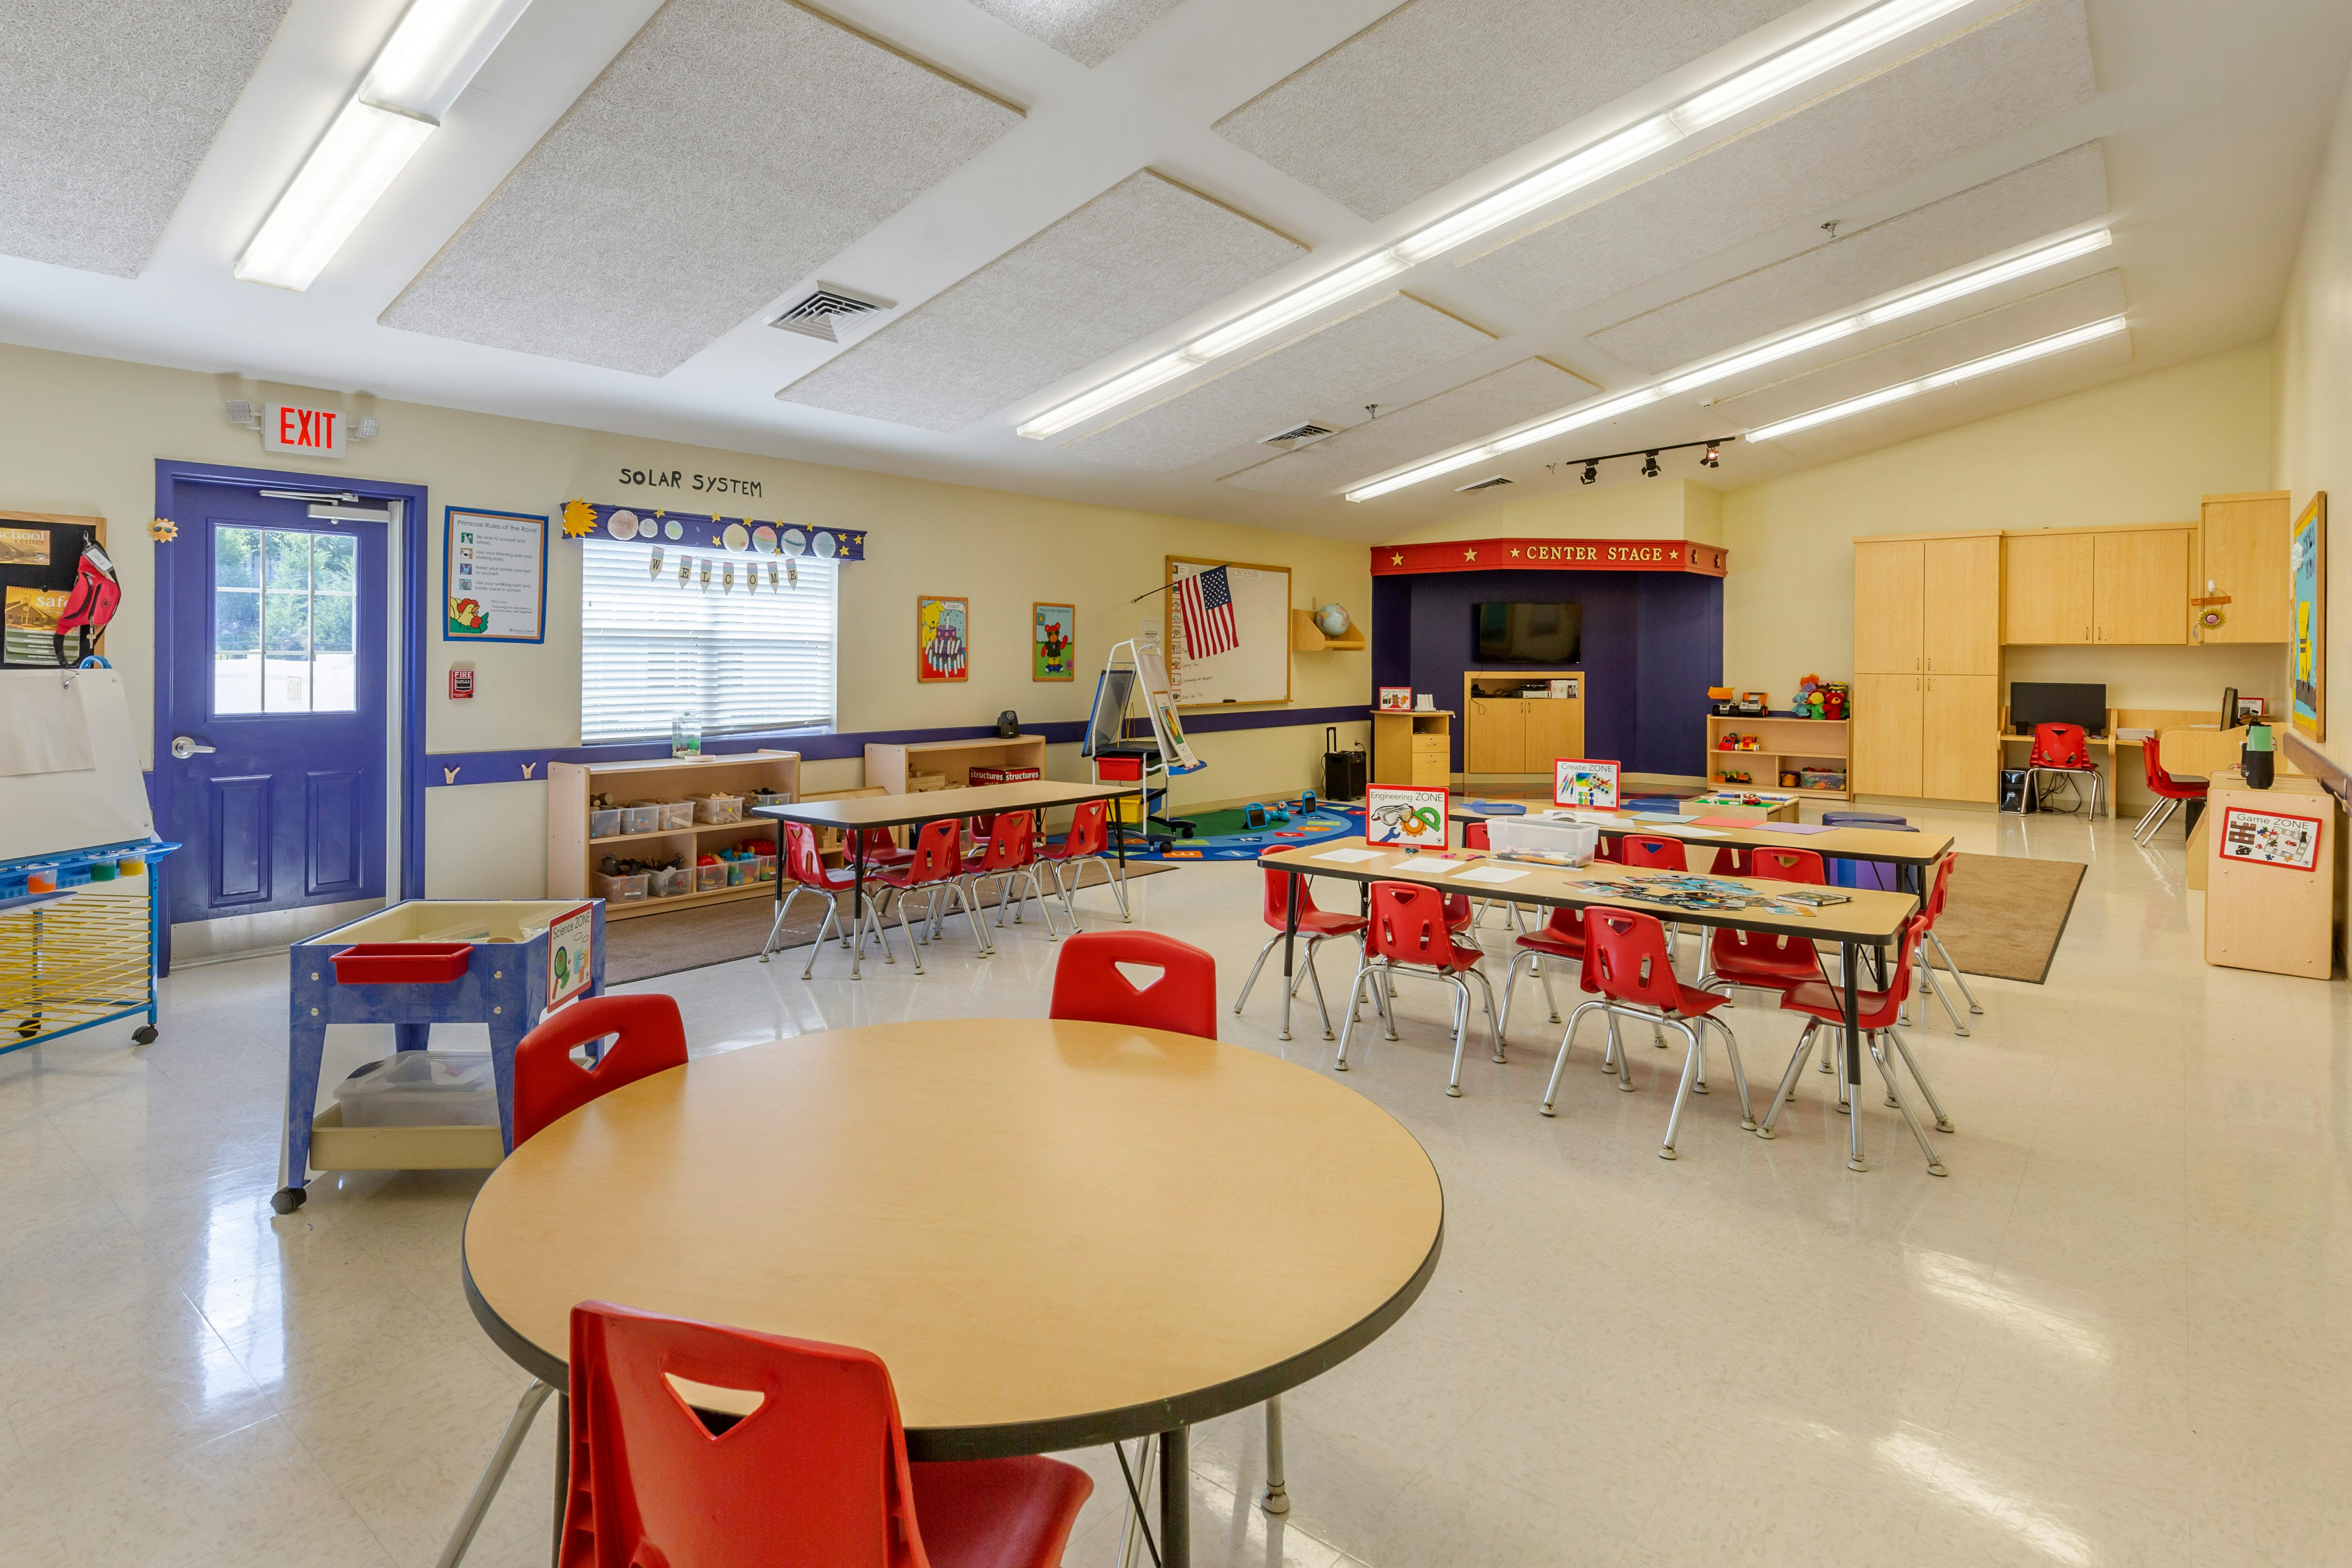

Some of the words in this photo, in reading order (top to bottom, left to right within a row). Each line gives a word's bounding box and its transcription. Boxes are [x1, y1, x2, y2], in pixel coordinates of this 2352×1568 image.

[281, 407, 336, 449] EXIT
[619, 468, 682, 489] SOLAR
[692, 474, 762, 498] SYSTEM
[457, 519, 483, 528] Primrose
[1526, 546, 1597, 560] CENTER
[1607, 547, 1662, 561] STAGE
[652, 558, 797, 584] WELCOME
[970, 771, 1003, 780] structures
[1006, 772, 1038, 781] structures
[1371, 791, 1413, 802] Engineering
[1415, 793, 1443, 802] ZONE
[2237, 813, 2270, 824] Game
[2274, 818, 2310, 830] ZONE
[553, 923, 574, 940] Science
[575, 911, 590, 929] ZONE
